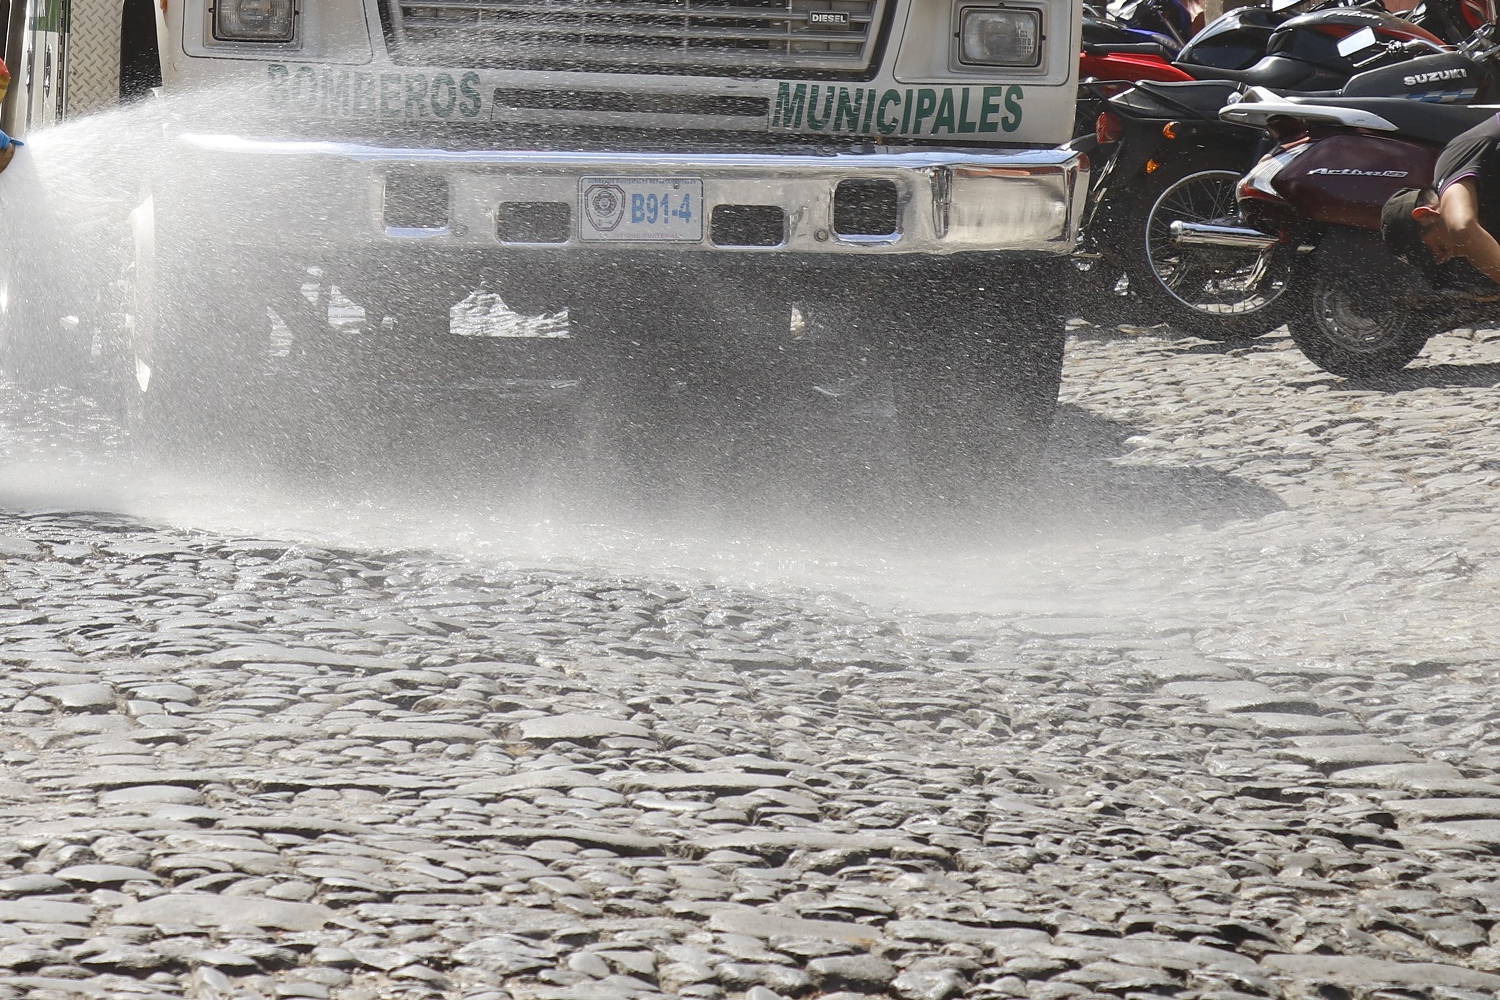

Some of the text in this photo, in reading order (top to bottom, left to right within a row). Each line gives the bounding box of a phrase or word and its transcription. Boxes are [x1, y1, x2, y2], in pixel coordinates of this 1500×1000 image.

[812, 14, 847, 23] DIESEL
[267, 63, 482, 119] BOMBEROS
[1403, 68, 1468, 86] SUZUKI
[772, 81, 1025, 135] MUNICIPALES
[631, 193, 692, 224] B91-4
